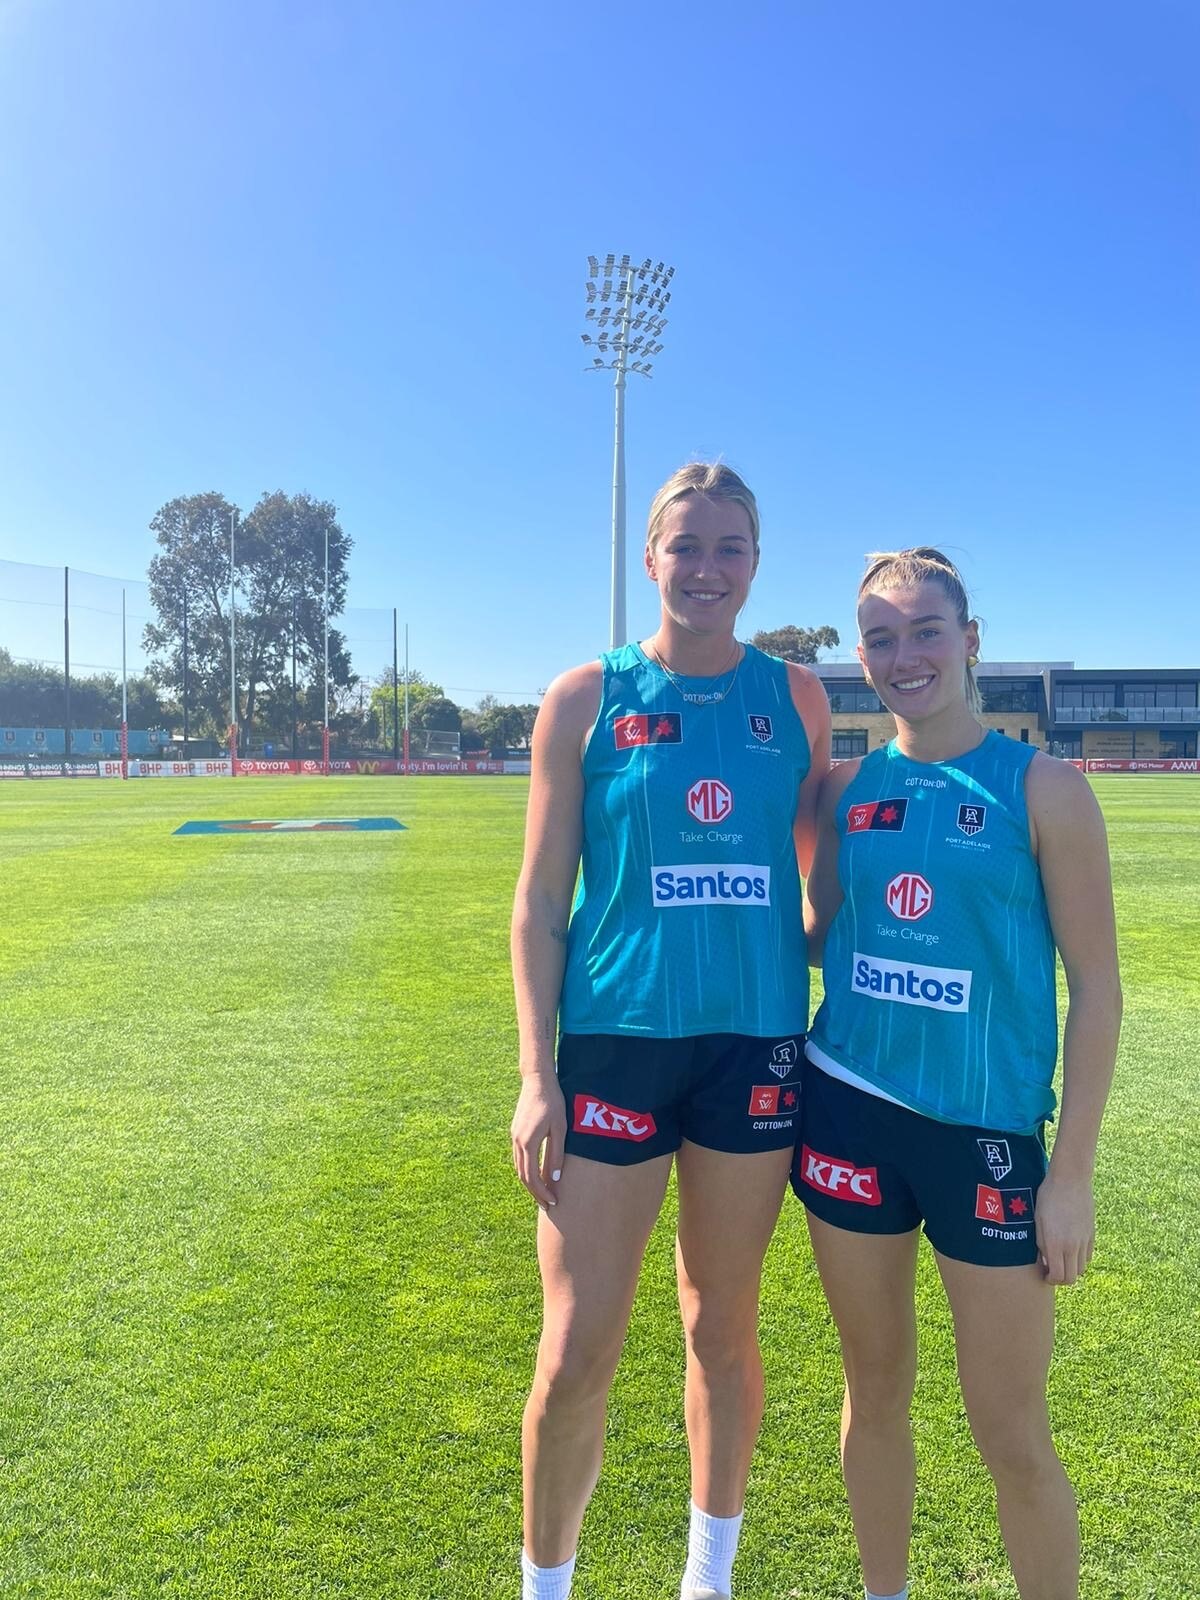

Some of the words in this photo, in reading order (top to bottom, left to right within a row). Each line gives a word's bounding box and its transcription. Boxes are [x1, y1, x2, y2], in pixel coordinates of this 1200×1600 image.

[105, 763, 122, 775] BH
[140, 763, 162, 775] BHP
[173, 763, 195, 775] BHP
[206, 763, 228, 774] BHP
[256, 761, 290, 770] TOYOTA
[319, 761, 351, 770] TYOTA
[1171, 761, 1198, 770] AAMI
[905, 777, 947, 789] COTTON:ON
[690, 782, 729, 820] MG
[679, 831, 703, 843] Take
[706, 830, 743, 845] Charge
[655, 871, 766, 901] Santos
[889, 876, 930, 917] MG
[876, 923, 898, 938] Take
[900, 927, 940, 946] Charge
[855, 960, 965, 1006] Santos
[580, 1102, 649, 1136] KFC
[805, 1155, 872, 1199] KFC
[981, 1226, 1028, 1240] COTTON:ON
